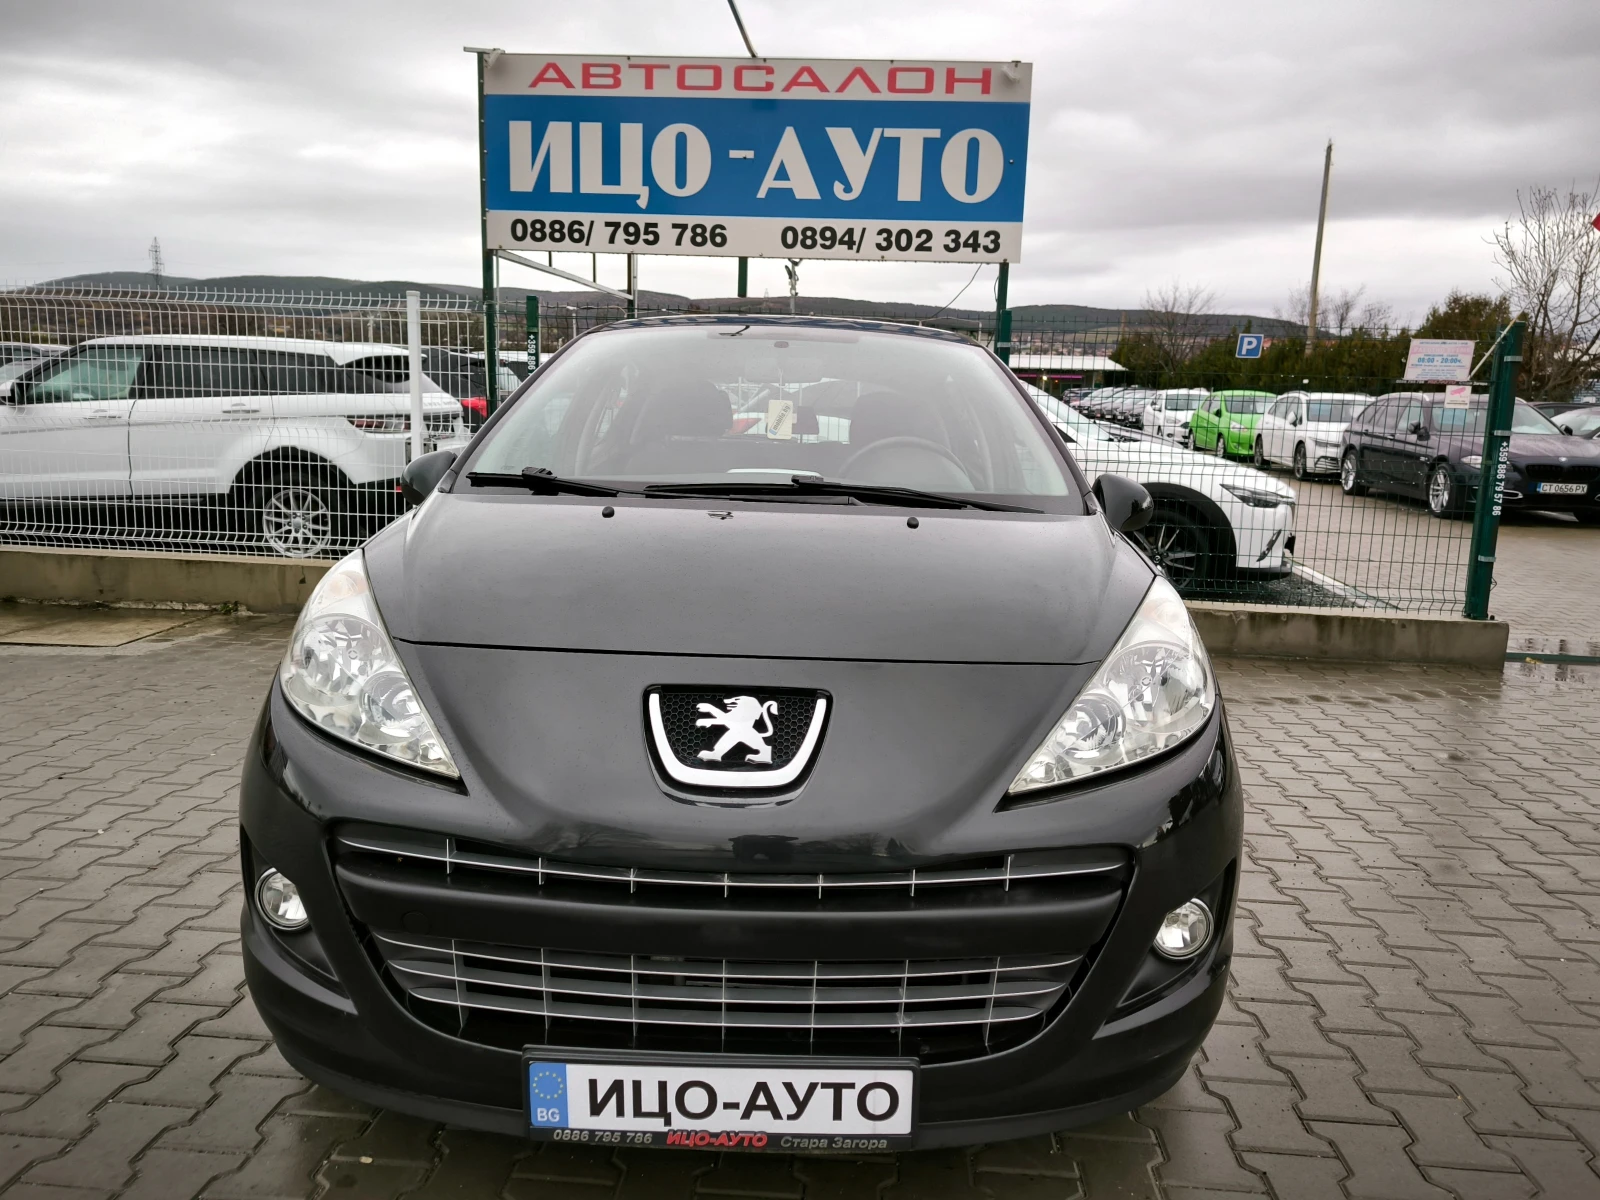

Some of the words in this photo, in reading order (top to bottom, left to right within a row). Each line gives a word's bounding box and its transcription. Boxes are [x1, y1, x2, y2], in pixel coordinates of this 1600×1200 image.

[528, 62, 992, 95] АВТОСАЛОН
[510, 218, 595, 246] 0886/
[604, 221, 660, 245] 795
[671, 223, 728, 247] 786
[781, 226, 866, 253] 0894/
[875, 228, 933, 252] 302
[943, 230, 1001, 253] 343
[527, 334, 536, 354] +359
[1241, 337, 1258, 355] P
[527, 356, 536, 370] 886
[1499, 441, 1509, 462] +359
[1497, 464, 1507, 479] 886
[1495, 481, 1505, 491] 79
[1493, 493, 1503, 503] 57
[1492, 505, 1502, 516] 86
[588, 1079, 900, 1127] ИЦО-АУТО
[537, 1108, 560, 1122] BG
[553, 1129, 589, 1141] 0886
[594, 1131, 621, 1143] 795
[626, 1132, 653, 1144] 786
[666, 1129, 768, 1147] ИЦО-АУТО
[780, 1136, 828, 1149] Стара
[832, 1137, 888, 1149] Загора
